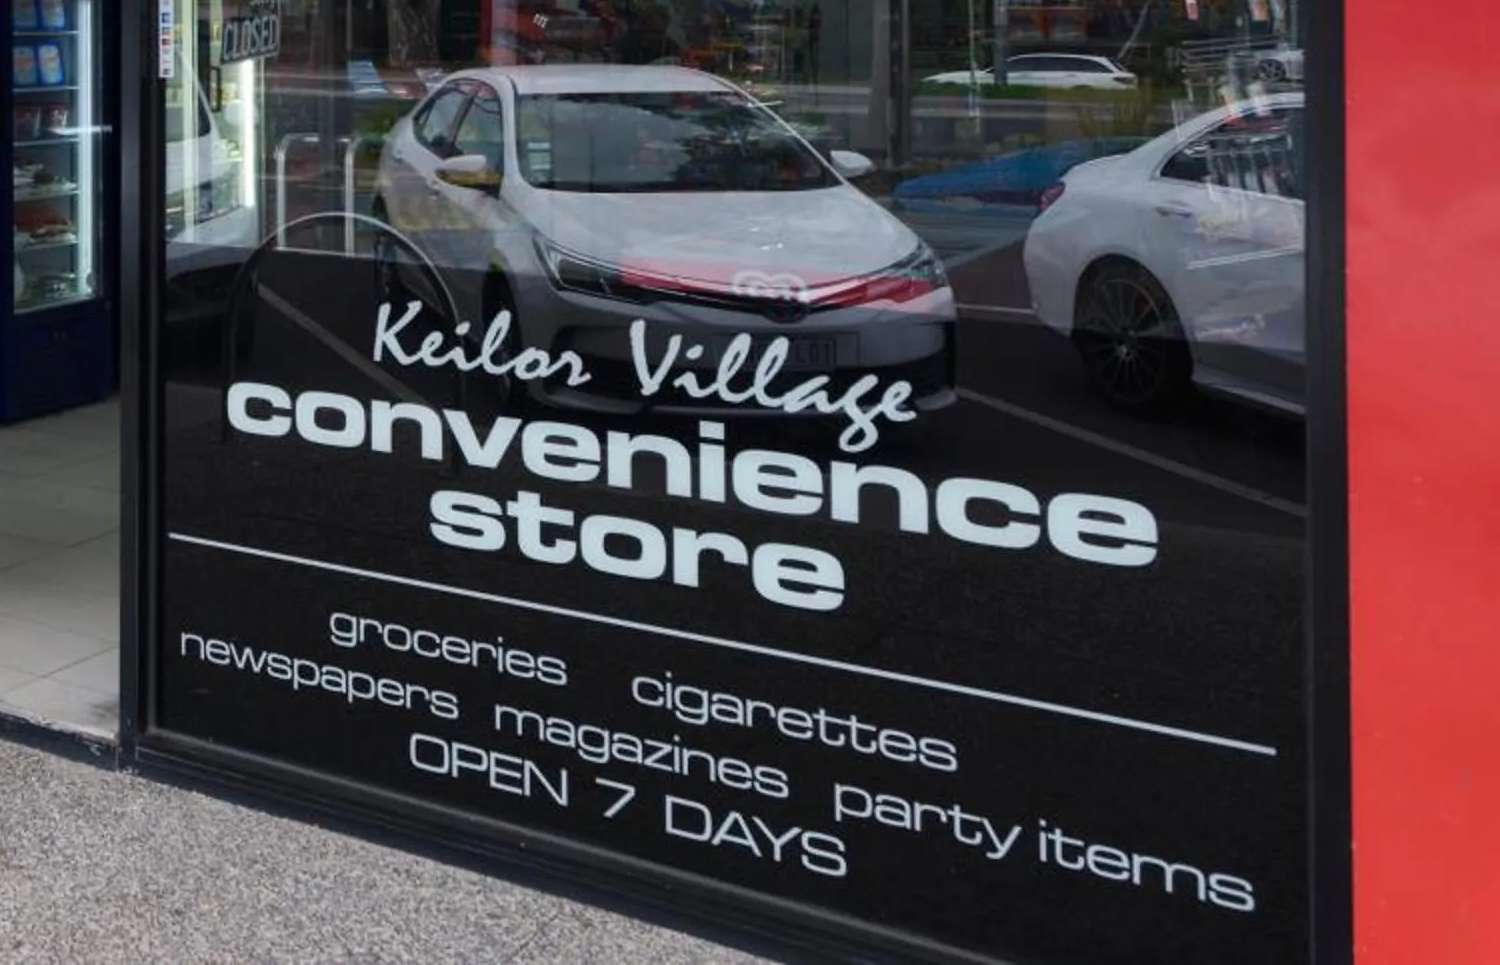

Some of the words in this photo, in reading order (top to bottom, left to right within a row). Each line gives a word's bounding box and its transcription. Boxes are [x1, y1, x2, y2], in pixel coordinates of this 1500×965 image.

[222, 13, 279, 61] CLOSED
[373, 299, 592, 387] Keilor
[628, 318, 917, 453] Village
[226, 381, 1159, 568] convenience
[429, 489, 846, 612] store
[329, 611, 568, 687] groceries
[631, 671, 959, 773] cigarettes
[179, 631, 460, 720] newspapers
[493, 704, 789, 799] magazines
[834, 782, 1023, 860] party
[1038, 818, 1256, 913] items
[409, 732, 570, 808] OPEN
[594, 776, 636, 819] 7
[664, 794, 848, 877] DAYS
